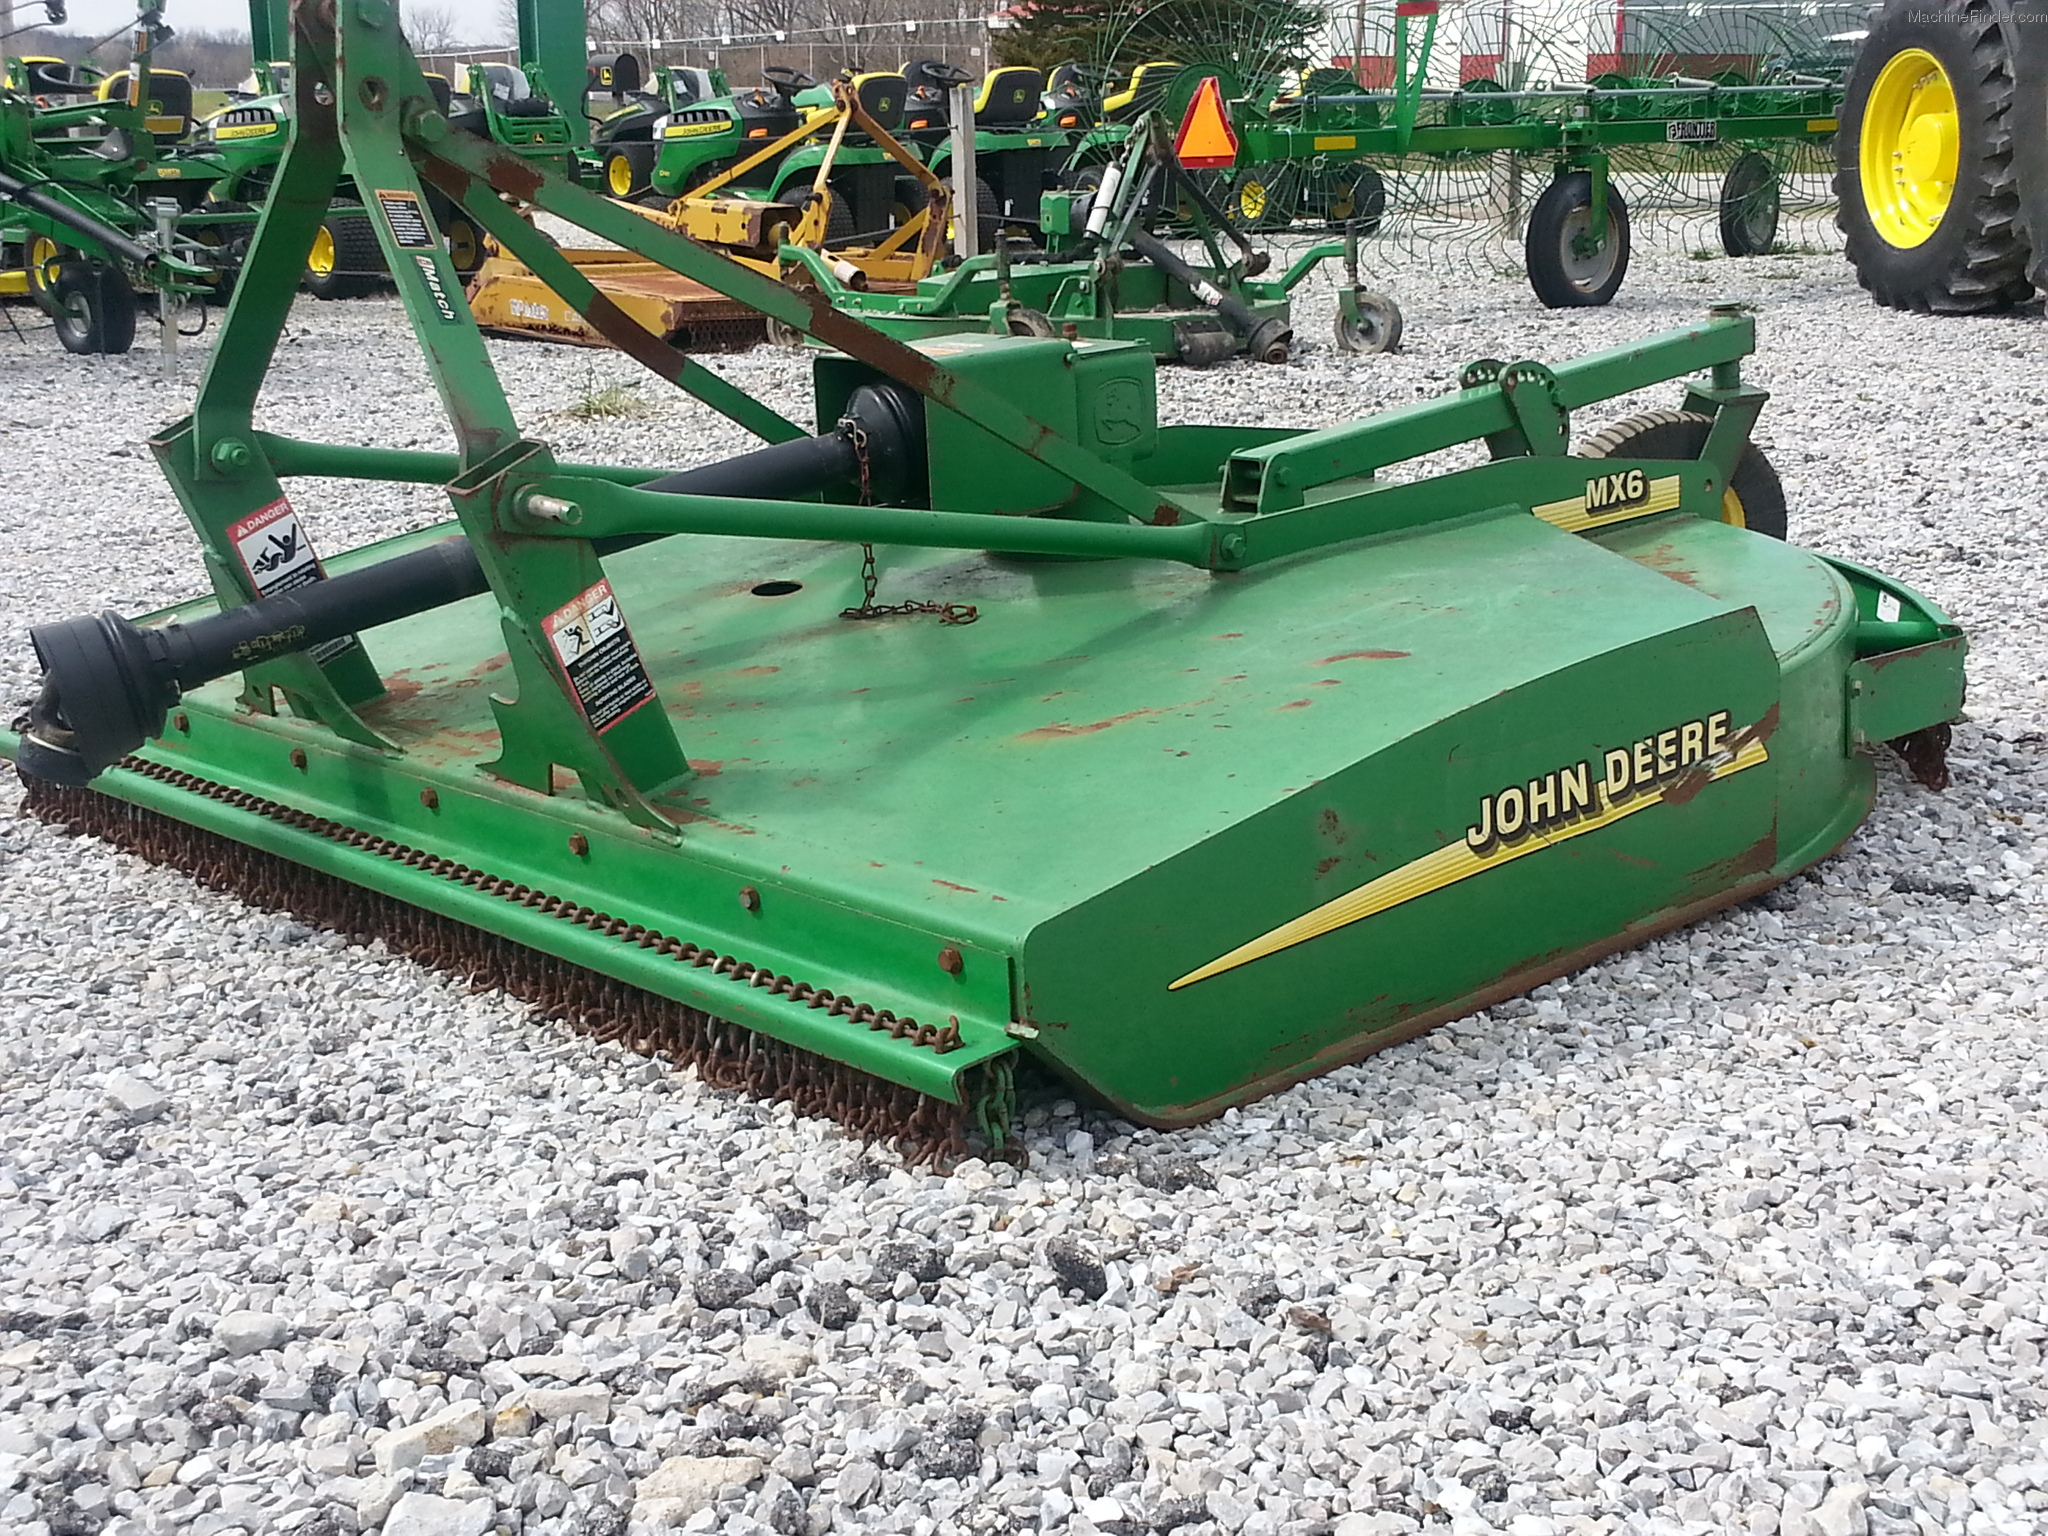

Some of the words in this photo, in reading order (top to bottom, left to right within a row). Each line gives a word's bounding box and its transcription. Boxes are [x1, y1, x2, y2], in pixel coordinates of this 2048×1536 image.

[1586, 469, 1646, 512] MX6
[247, 501, 289, 530] DANGER
[563, 584, 608, 619] DANGER
[1466, 761, 1589, 846] JOHN
[1604, 709, 1729, 796] DEERE
